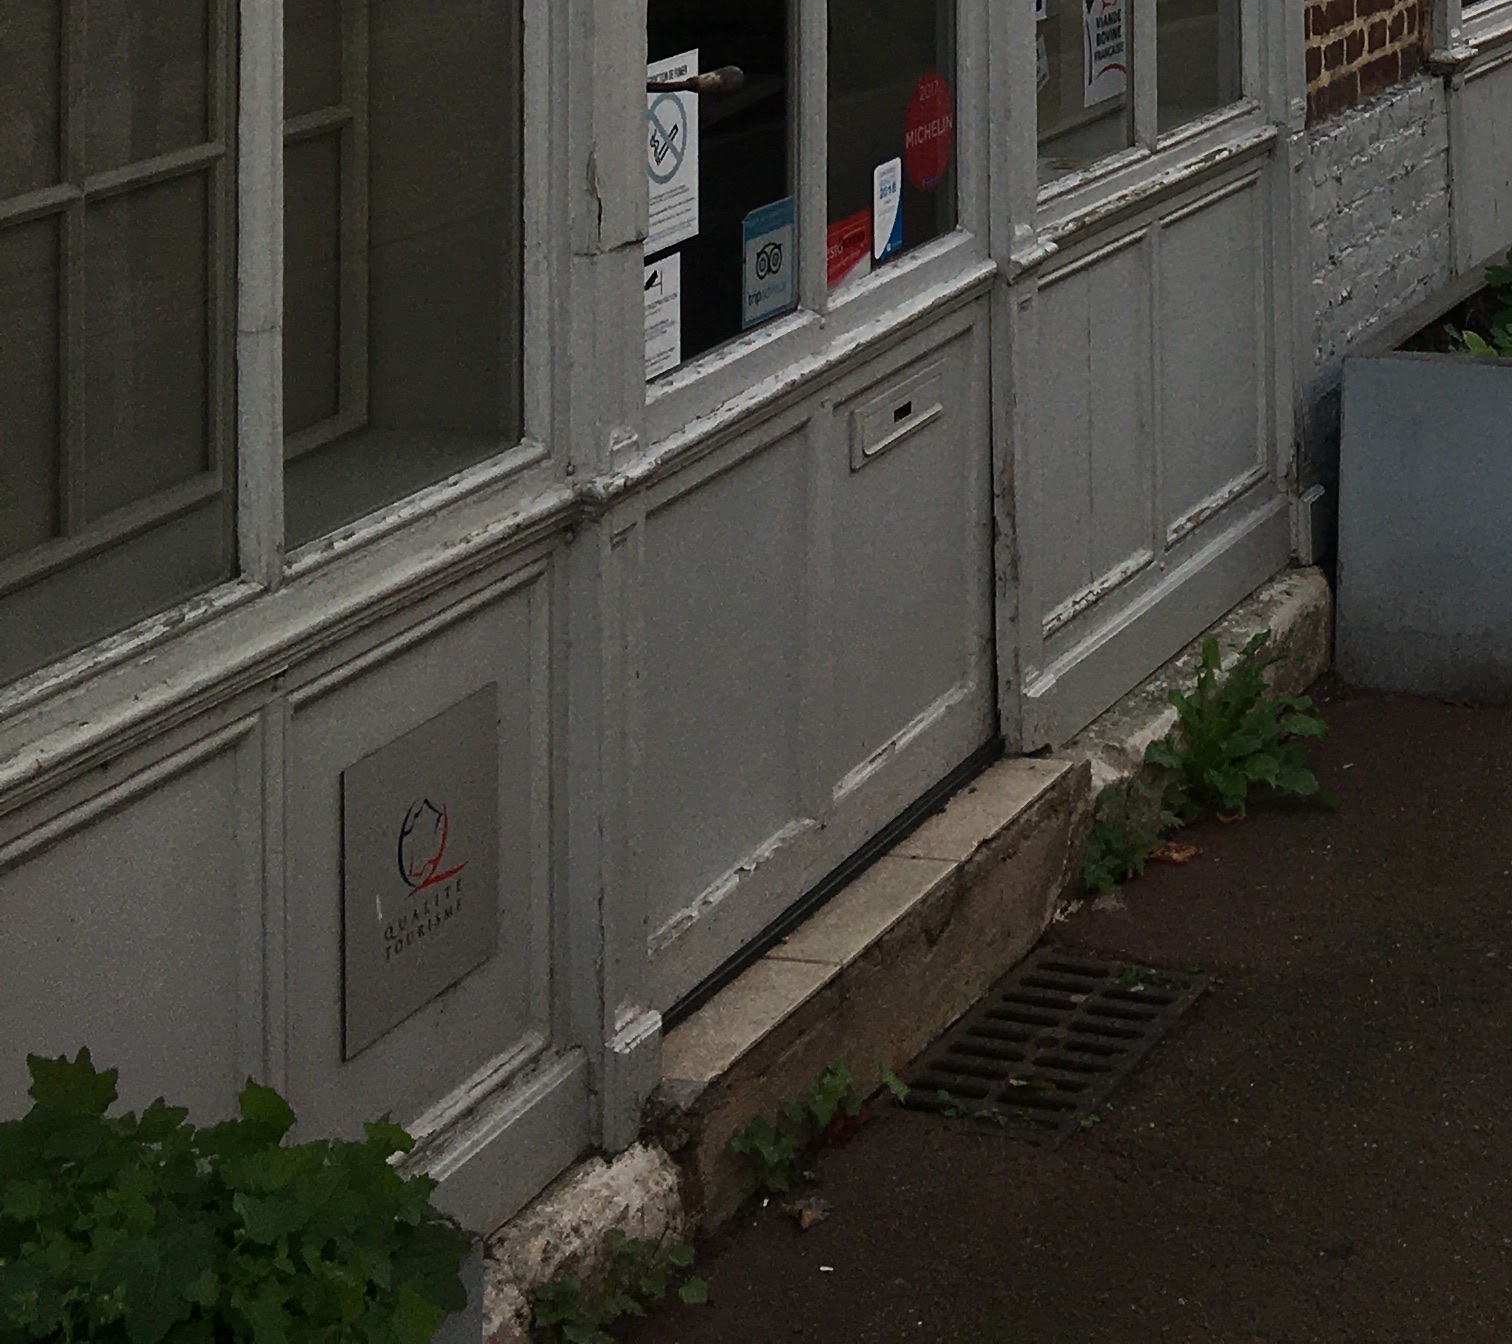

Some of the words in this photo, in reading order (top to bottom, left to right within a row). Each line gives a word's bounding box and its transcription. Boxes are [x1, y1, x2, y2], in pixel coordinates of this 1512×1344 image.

[919, 79, 939, 101] 2017
[905, 112, 953, 149] MICHELIN
[383, 898, 462, 961] TOURISME
